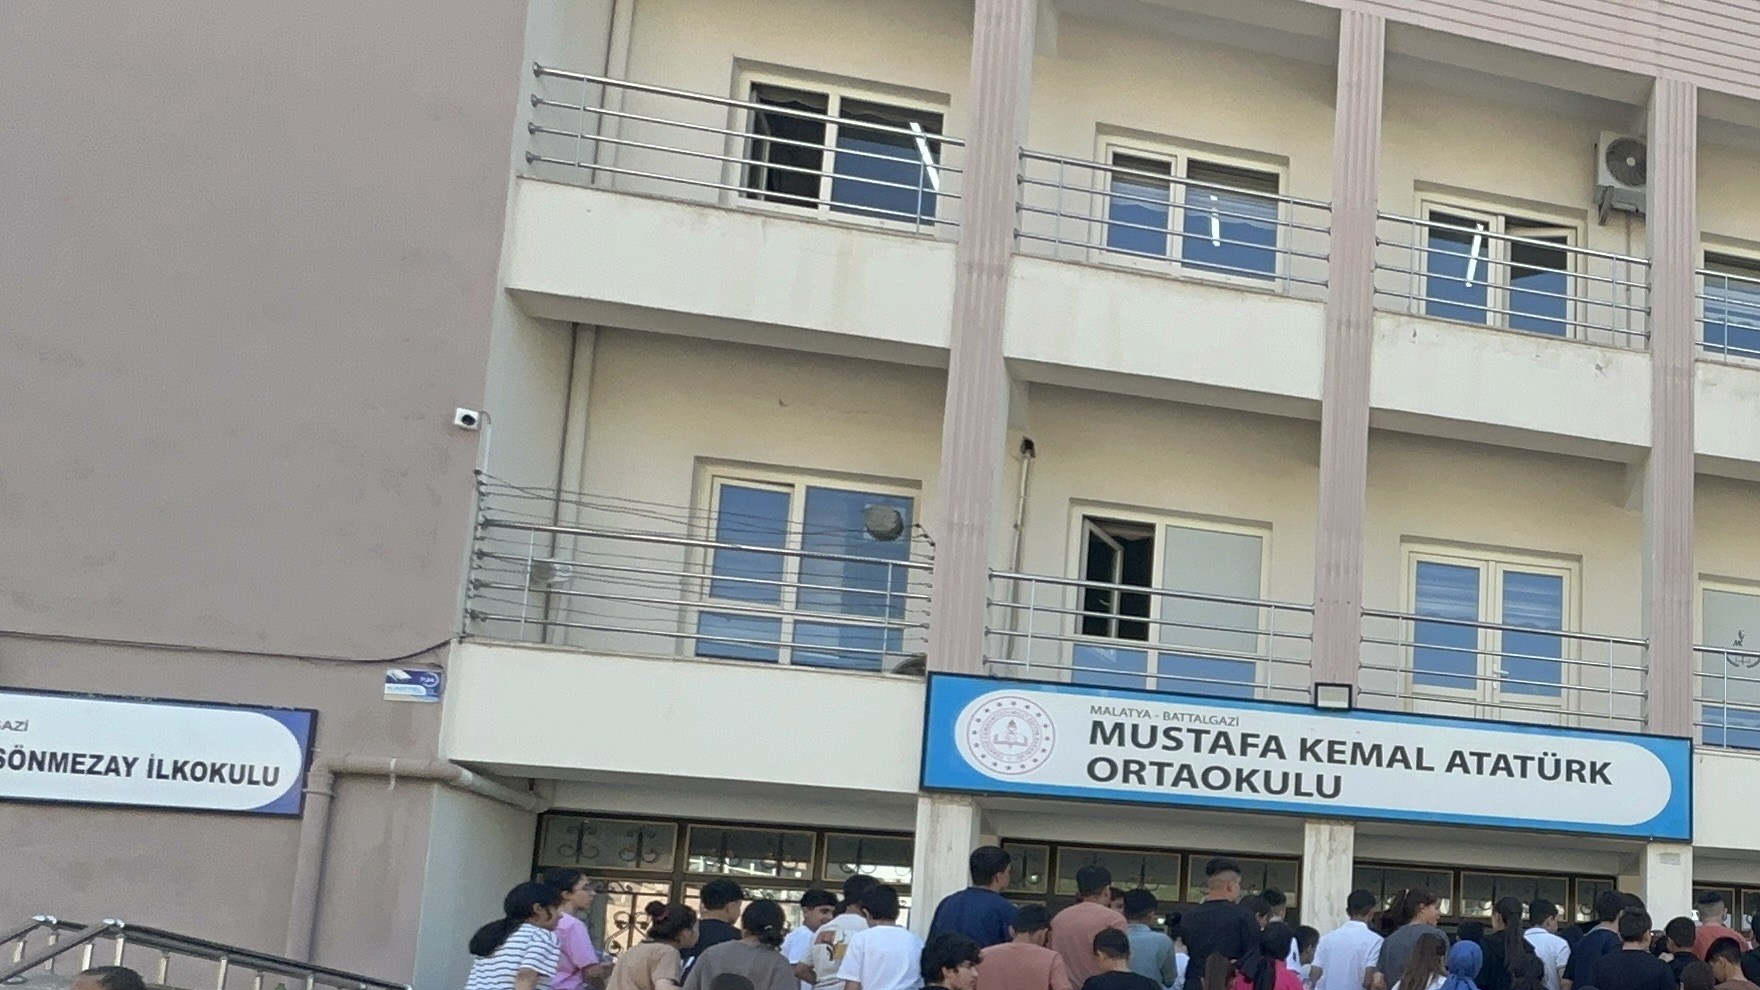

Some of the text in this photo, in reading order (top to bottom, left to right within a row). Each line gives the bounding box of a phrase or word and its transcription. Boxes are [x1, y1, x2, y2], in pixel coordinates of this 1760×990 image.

[0, 719, 29, 732] AZİ
[1090, 705, 1151, 720] MALATYA
[1163, 711, 1239, 727] BATTALGAZİ
[147, 753, 280, 787] İLKOKULU
[1089, 720, 1613, 786] MUSTAFA KEMAL ATATÜRK
[1087, 757, 1342, 799] ORTAOKULU
